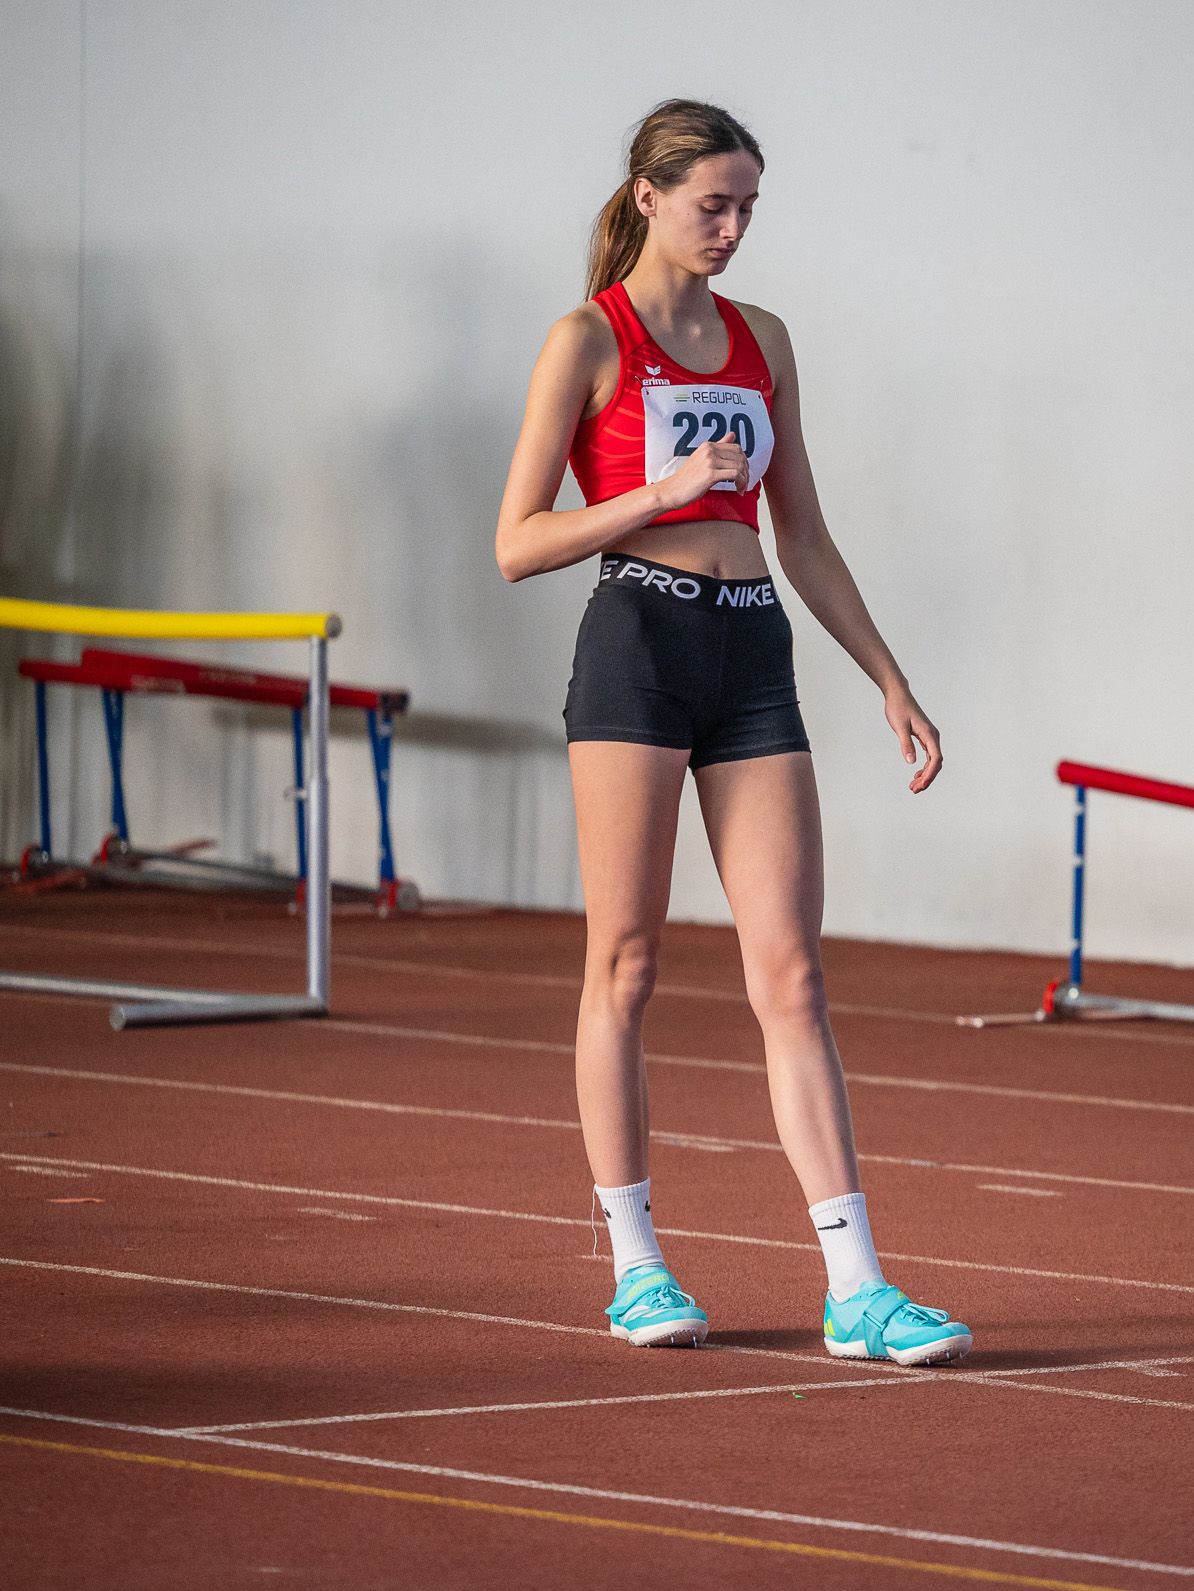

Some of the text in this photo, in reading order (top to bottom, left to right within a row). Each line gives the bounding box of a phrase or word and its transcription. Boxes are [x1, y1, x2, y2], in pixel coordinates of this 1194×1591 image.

[642, 377, 670, 386] erima
[692, 391, 746, 405] REGUPOL
[672, 411, 755, 458] 220
[616, 562, 701, 599] PRO
[716, 583, 774, 607] NIKE
